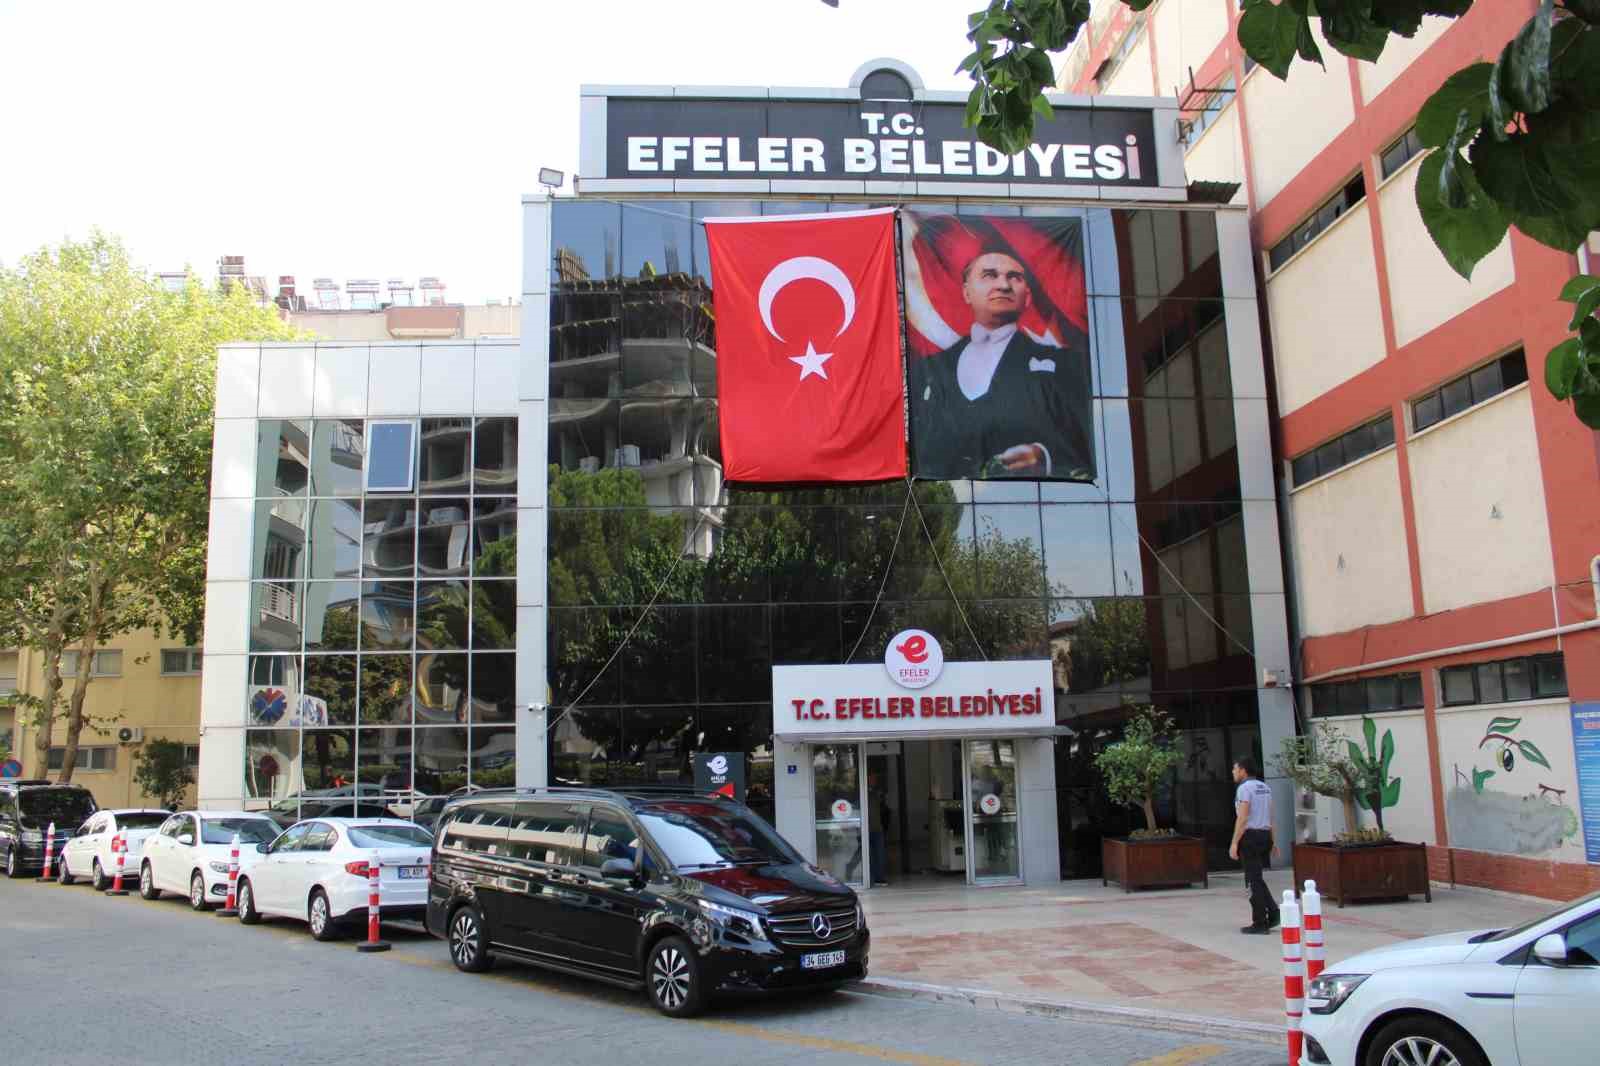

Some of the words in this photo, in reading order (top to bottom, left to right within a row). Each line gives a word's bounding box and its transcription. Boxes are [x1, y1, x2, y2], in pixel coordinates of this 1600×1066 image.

[861, 112, 925, 136] T.C.
[627, 136, 827, 172] EFELER
[791, 698, 831, 721] T.C.
[834, 696, 915, 720] EFELER
[920, 687, 1042, 718] BELEDİYESİ
